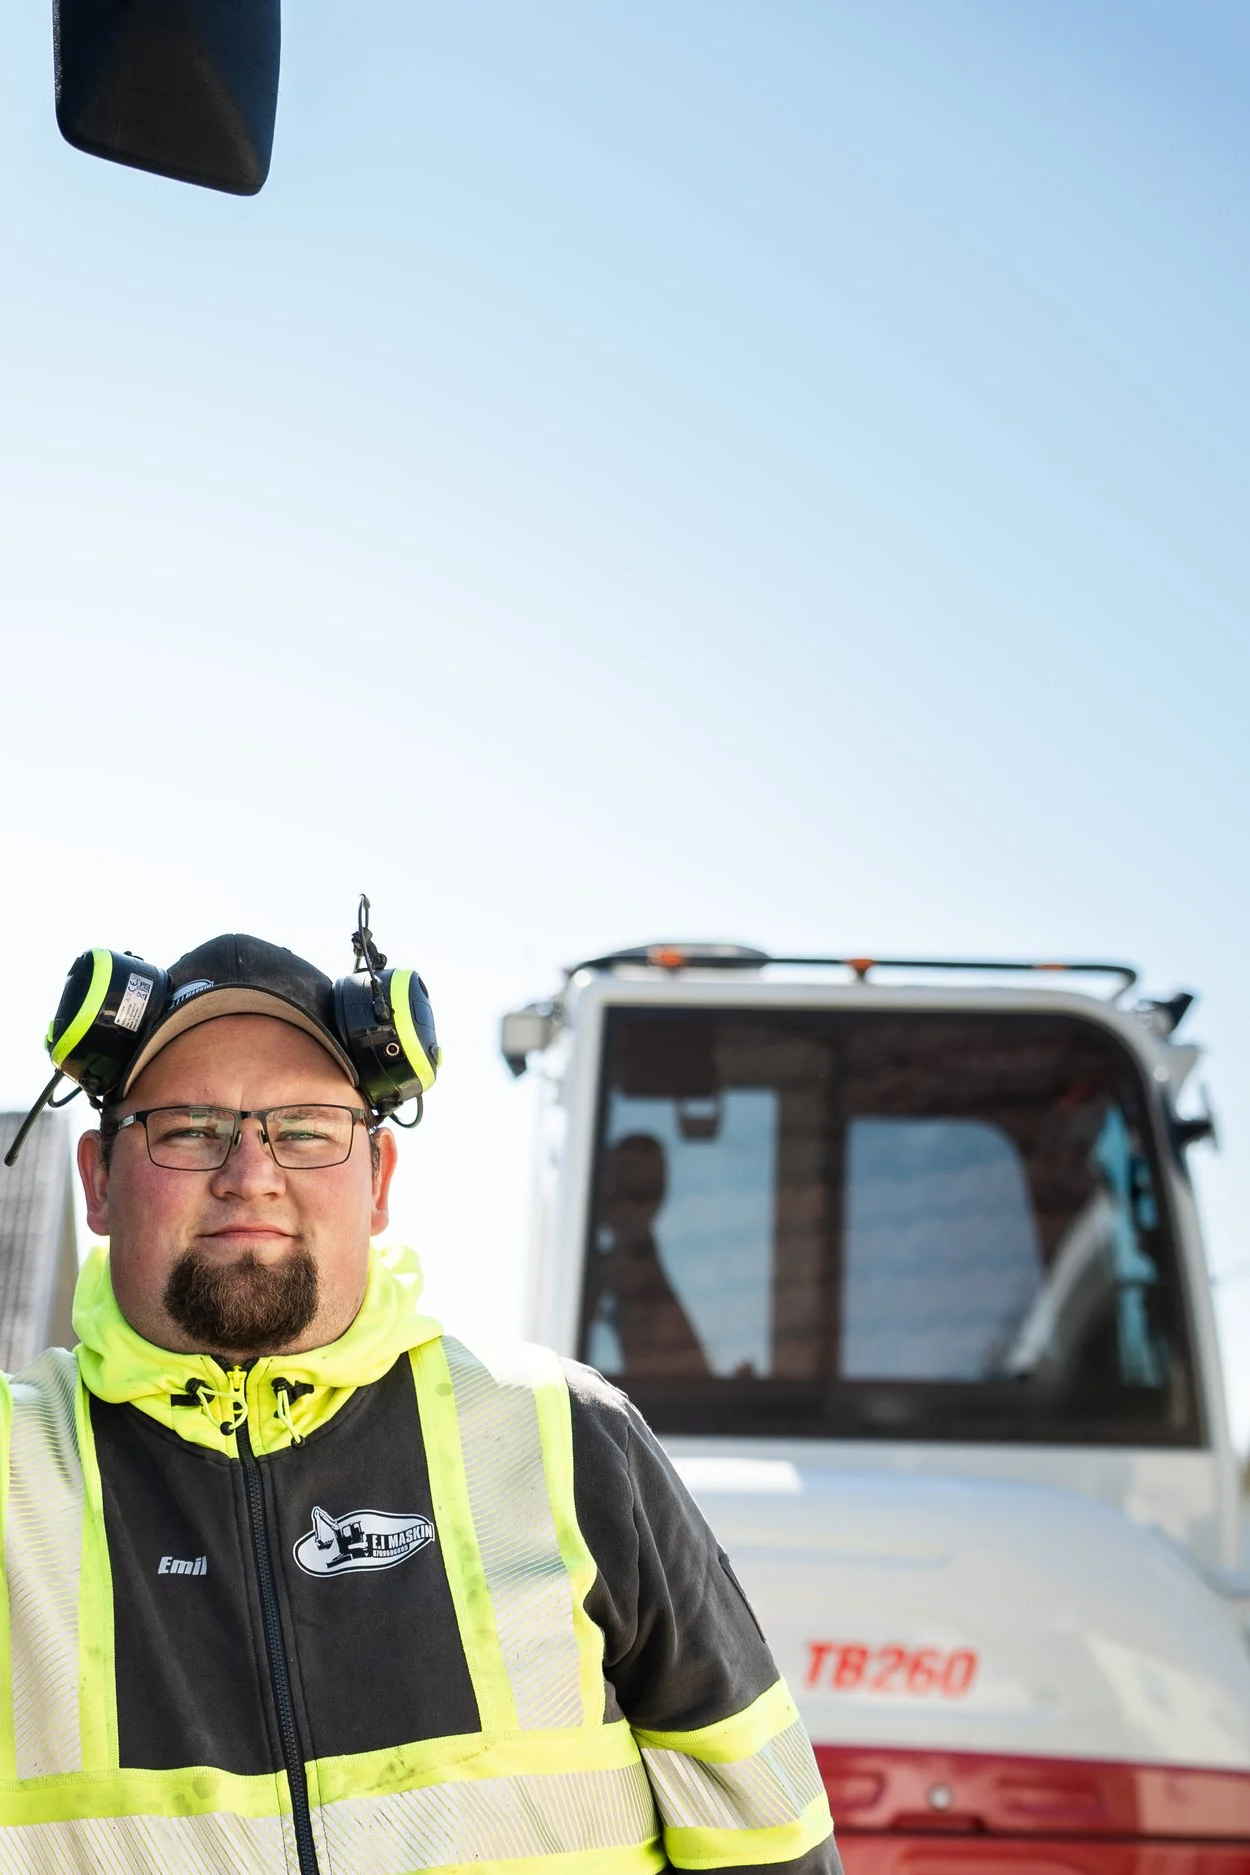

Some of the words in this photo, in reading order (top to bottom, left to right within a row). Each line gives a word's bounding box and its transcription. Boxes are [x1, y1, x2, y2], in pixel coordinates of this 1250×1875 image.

[388, 1524, 433, 1548] MASKIN
[158, 1556, 207, 1575] Emil
[805, 1639, 979, 1700] TB260
